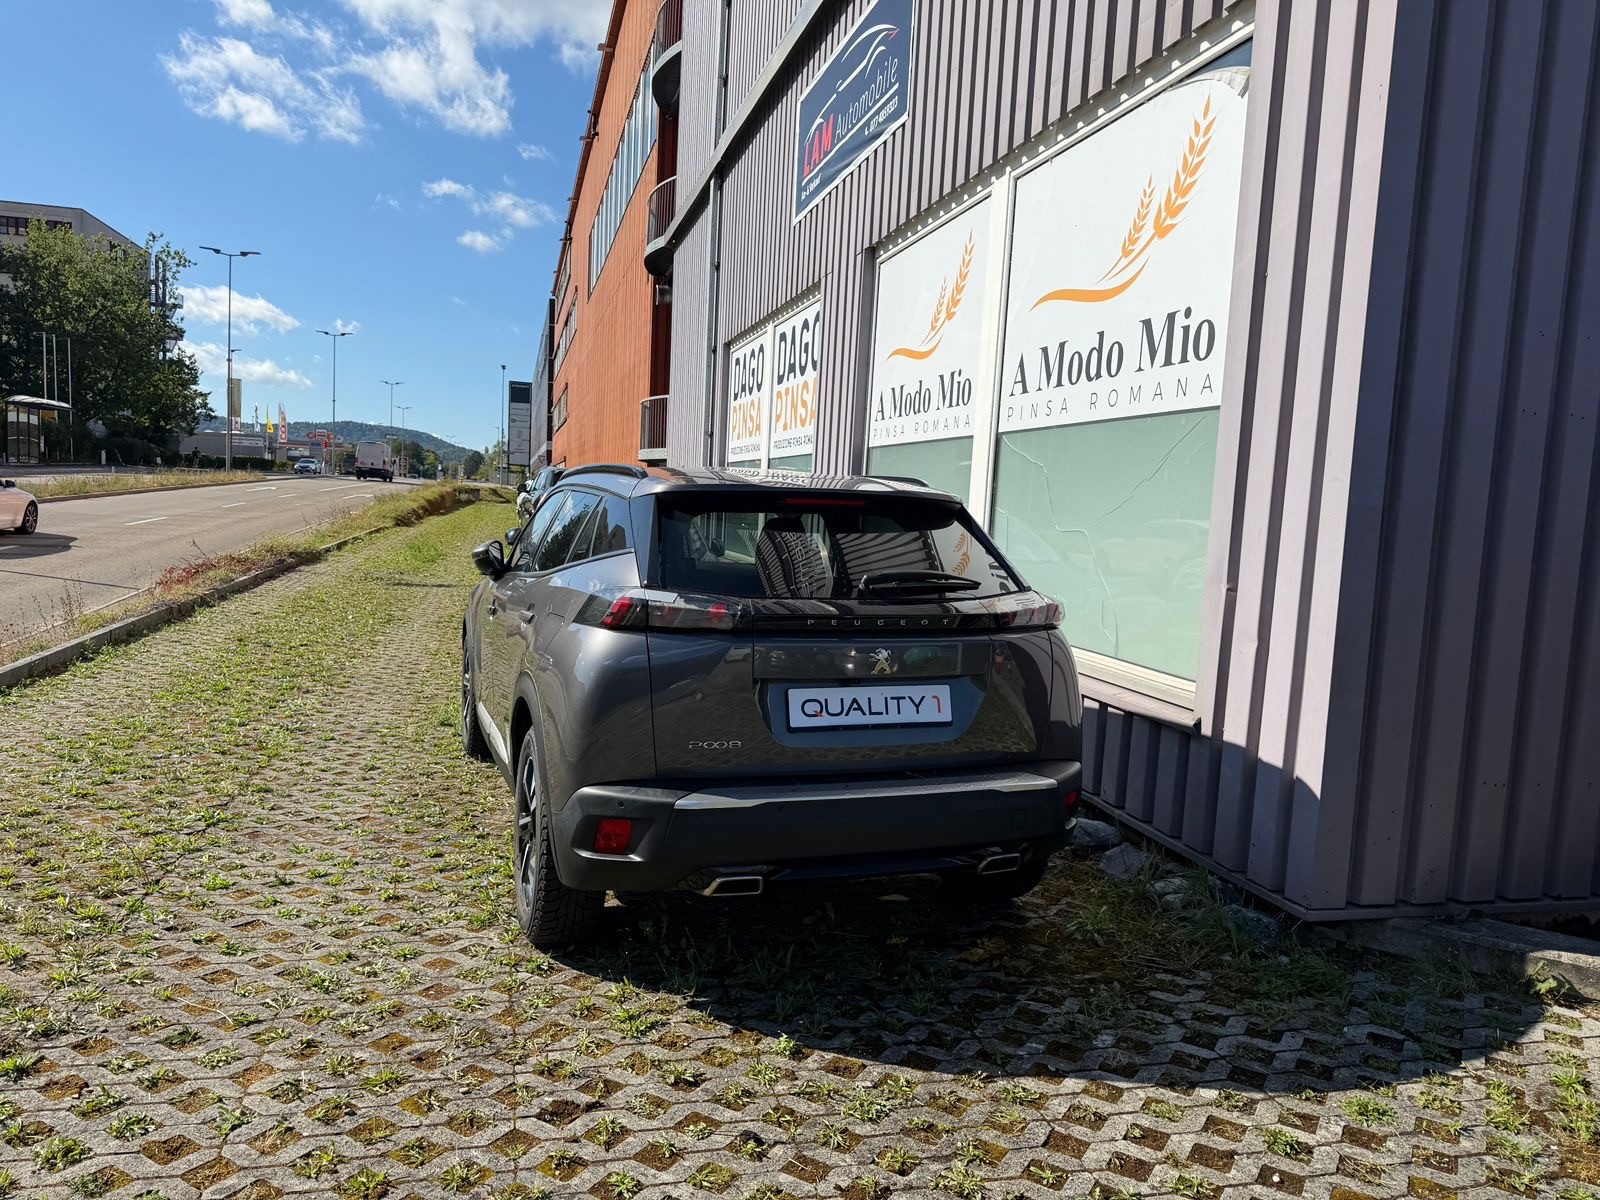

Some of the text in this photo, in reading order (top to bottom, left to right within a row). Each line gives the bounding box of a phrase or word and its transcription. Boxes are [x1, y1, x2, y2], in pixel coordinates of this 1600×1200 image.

[803, 57, 899, 177] LAM Automobile
[733, 343, 764, 401] DAGO
[1009, 306, 1216, 397] A Modo Mio
[731, 397, 761, 441] PINSA
[775, 378, 818, 433] PINSA
[875, 368, 971, 422] A Modo Mio
[1007, 373, 1214, 423] PINSA ROMANA
[873, 414, 970, 439] PINSA ROMANA
[801, 695, 942, 718] QUALITY 1
[689, 740, 742, 749] 2008
